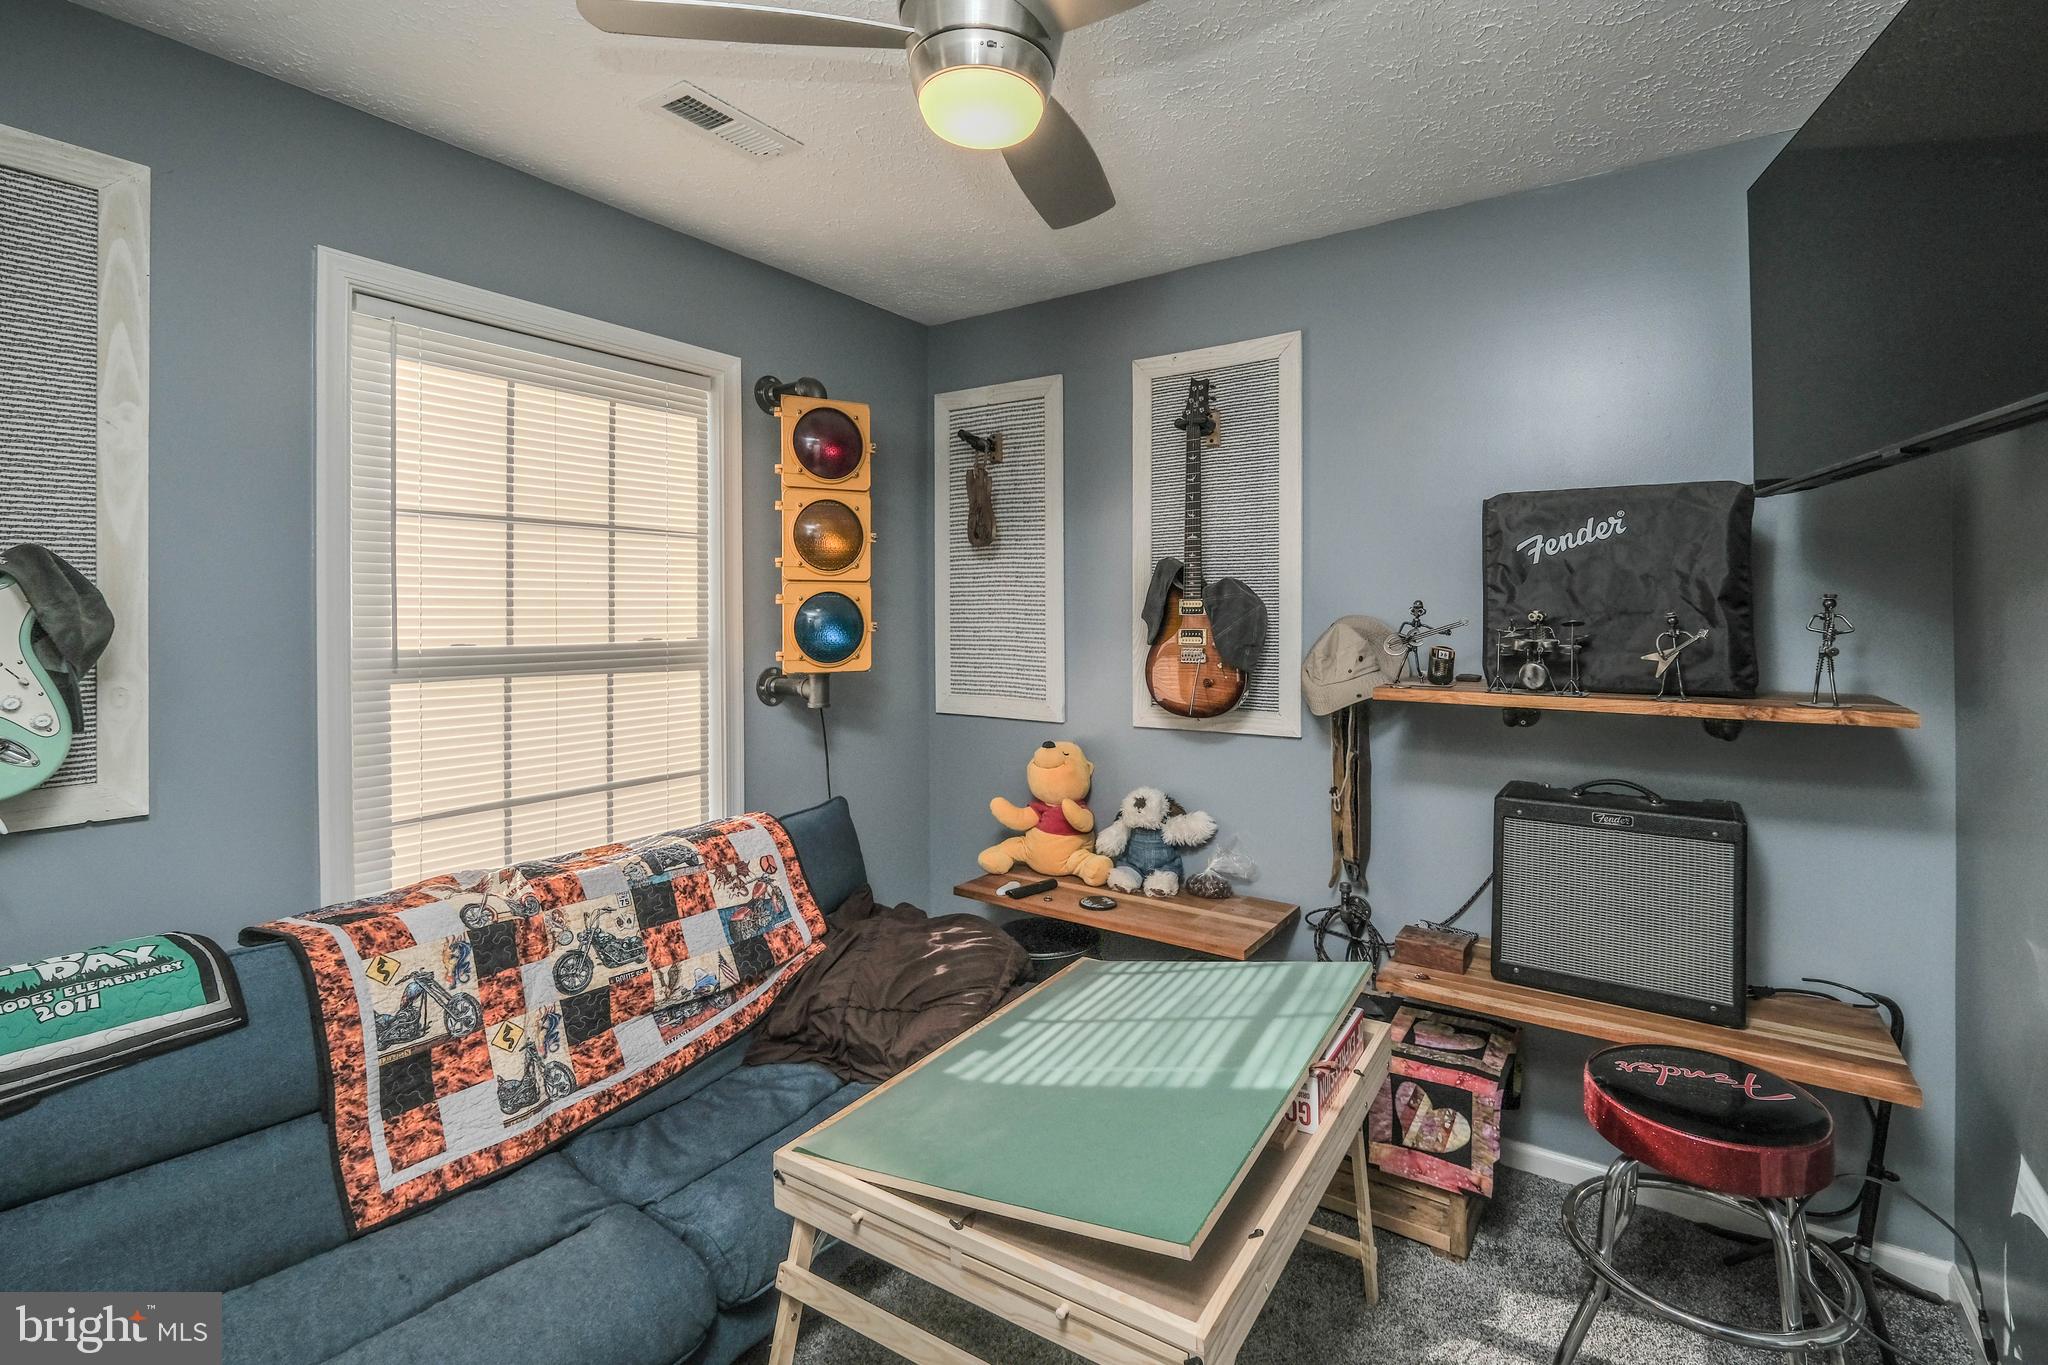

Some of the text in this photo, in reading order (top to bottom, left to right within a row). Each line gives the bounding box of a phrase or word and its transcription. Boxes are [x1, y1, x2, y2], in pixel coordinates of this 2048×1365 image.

[1516, 513, 1627, 565] Fender
[1595, 813, 1631, 825] Fender
[36, 944, 158, 981] DAY
[63, 960, 184, 998] ELEMENTARY
[615, 971, 635, 984] ROUTE
[33, 993, 101, 1024] 2011
[1615, 1060, 1797, 1100] Fender
